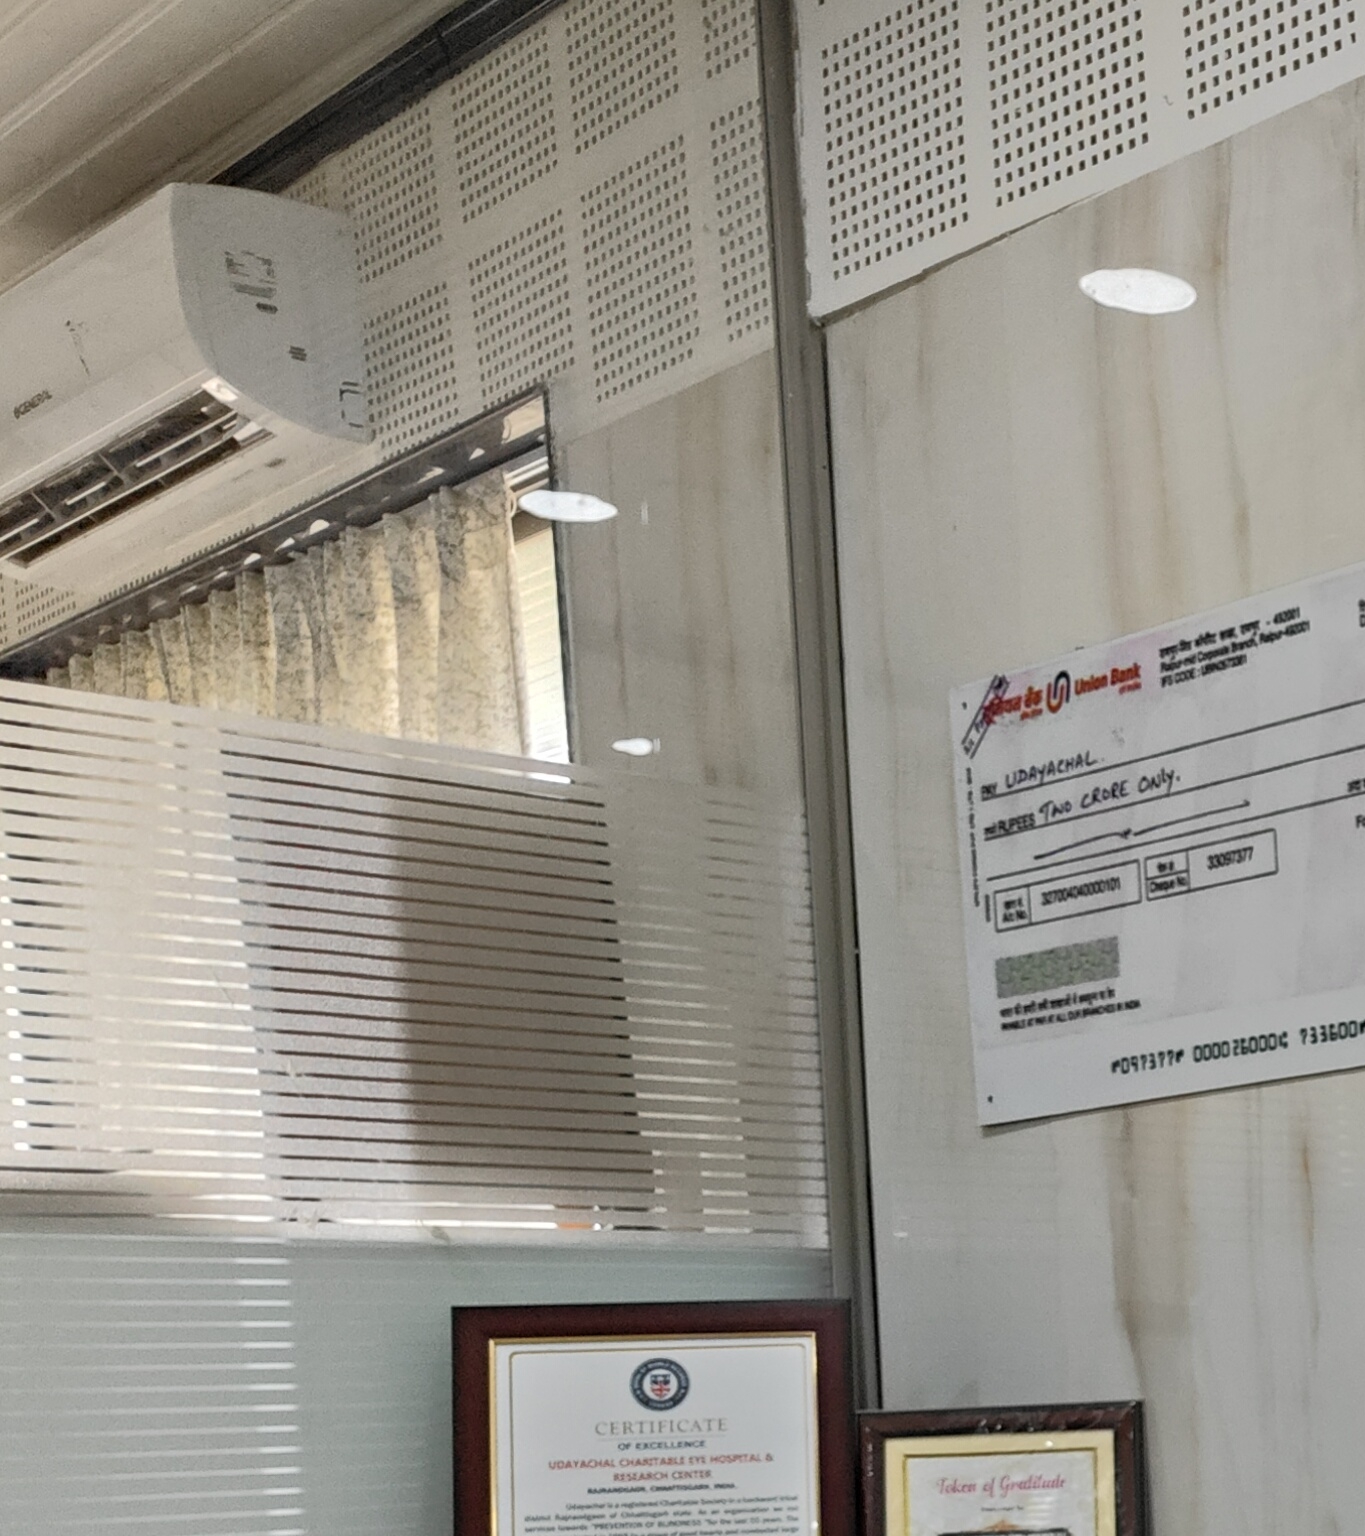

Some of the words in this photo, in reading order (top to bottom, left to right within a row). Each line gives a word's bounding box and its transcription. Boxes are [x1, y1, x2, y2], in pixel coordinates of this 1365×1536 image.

[1074, 674, 1107, 694] Union
[1109, 660, 1141, 685] Bank
[1080, 779, 1129, 808] CRORE
[595, 1418, 728, 1436] CERTIFICATE
[618, 1442, 631, 1450] OF
[636, 1440, 706, 1450] EXCELLENCE
[549, 1459, 615, 1470] UDAYACHAL
[619, 1457, 685, 1468] CHARITABLE
[710, 1454, 761, 1465] HOSPITAL
[613, 1471, 668, 1482] RESEARCH
[672, 1470, 712, 1480] CENTER
[936, 1479, 977, 1495] Token
[982, 1478, 997, 1498] of
[999, 1474, 1067, 1499] Gratitude
